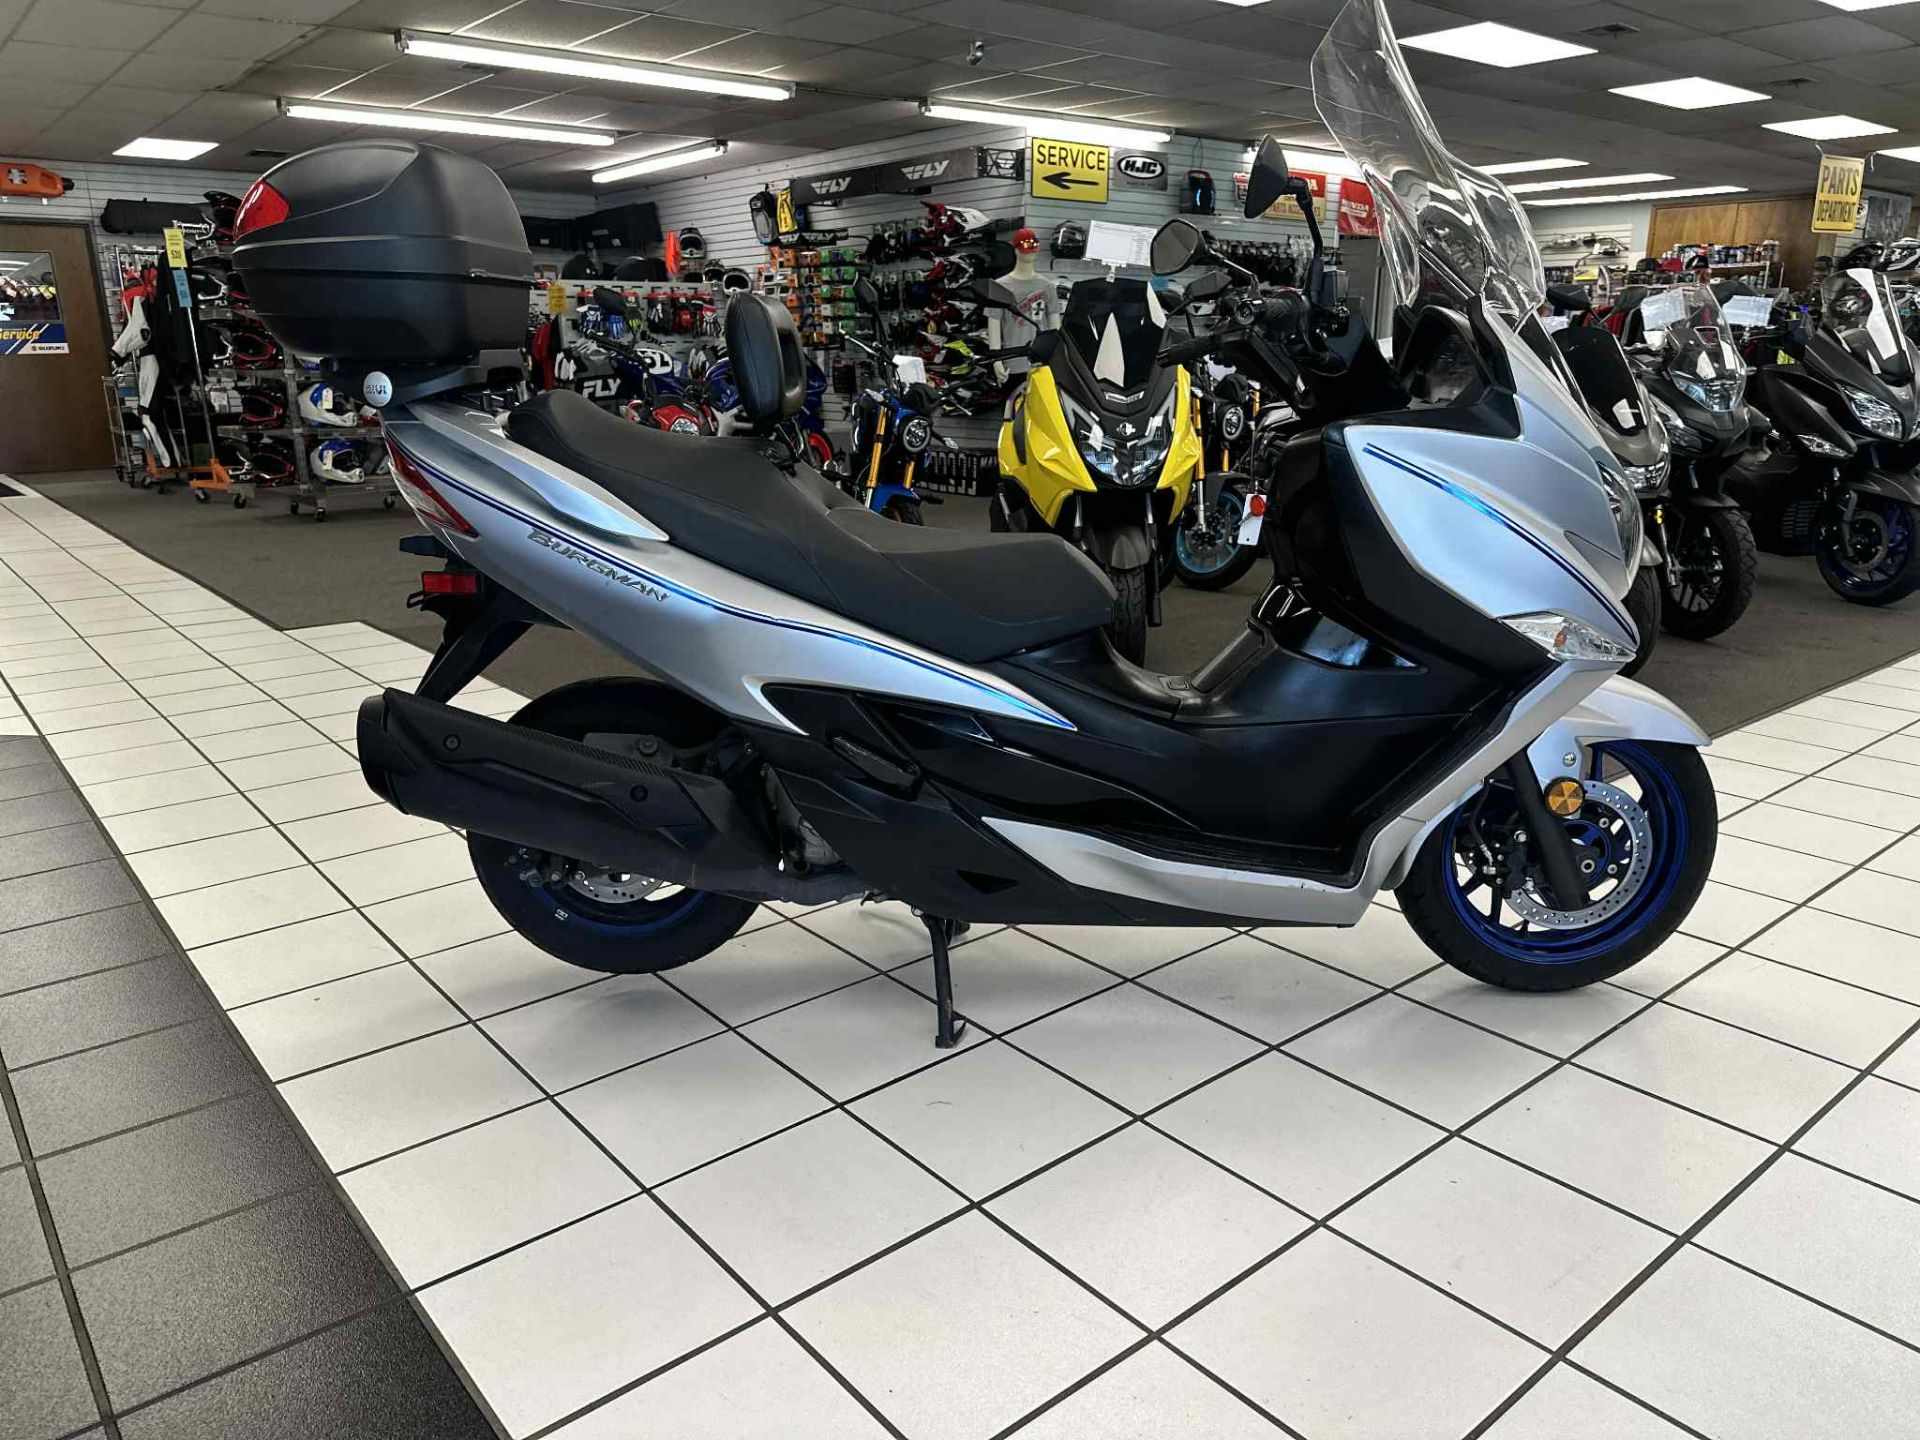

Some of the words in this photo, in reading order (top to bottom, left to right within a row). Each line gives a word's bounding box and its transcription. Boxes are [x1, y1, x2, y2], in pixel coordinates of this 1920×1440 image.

[1037, 144, 1106, 171] SERVICE
[1123, 159, 1158, 175] HJC
[901, 160, 949, 180] FLY
[1820, 165, 1860, 196] PARTS
[810, 177, 851, 194] FLY
[1816, 200, 1857, 222] DEPARTMENT
[582, 378, 622, 399] FLY
[527, 528, 671, 602] BURGMAN
